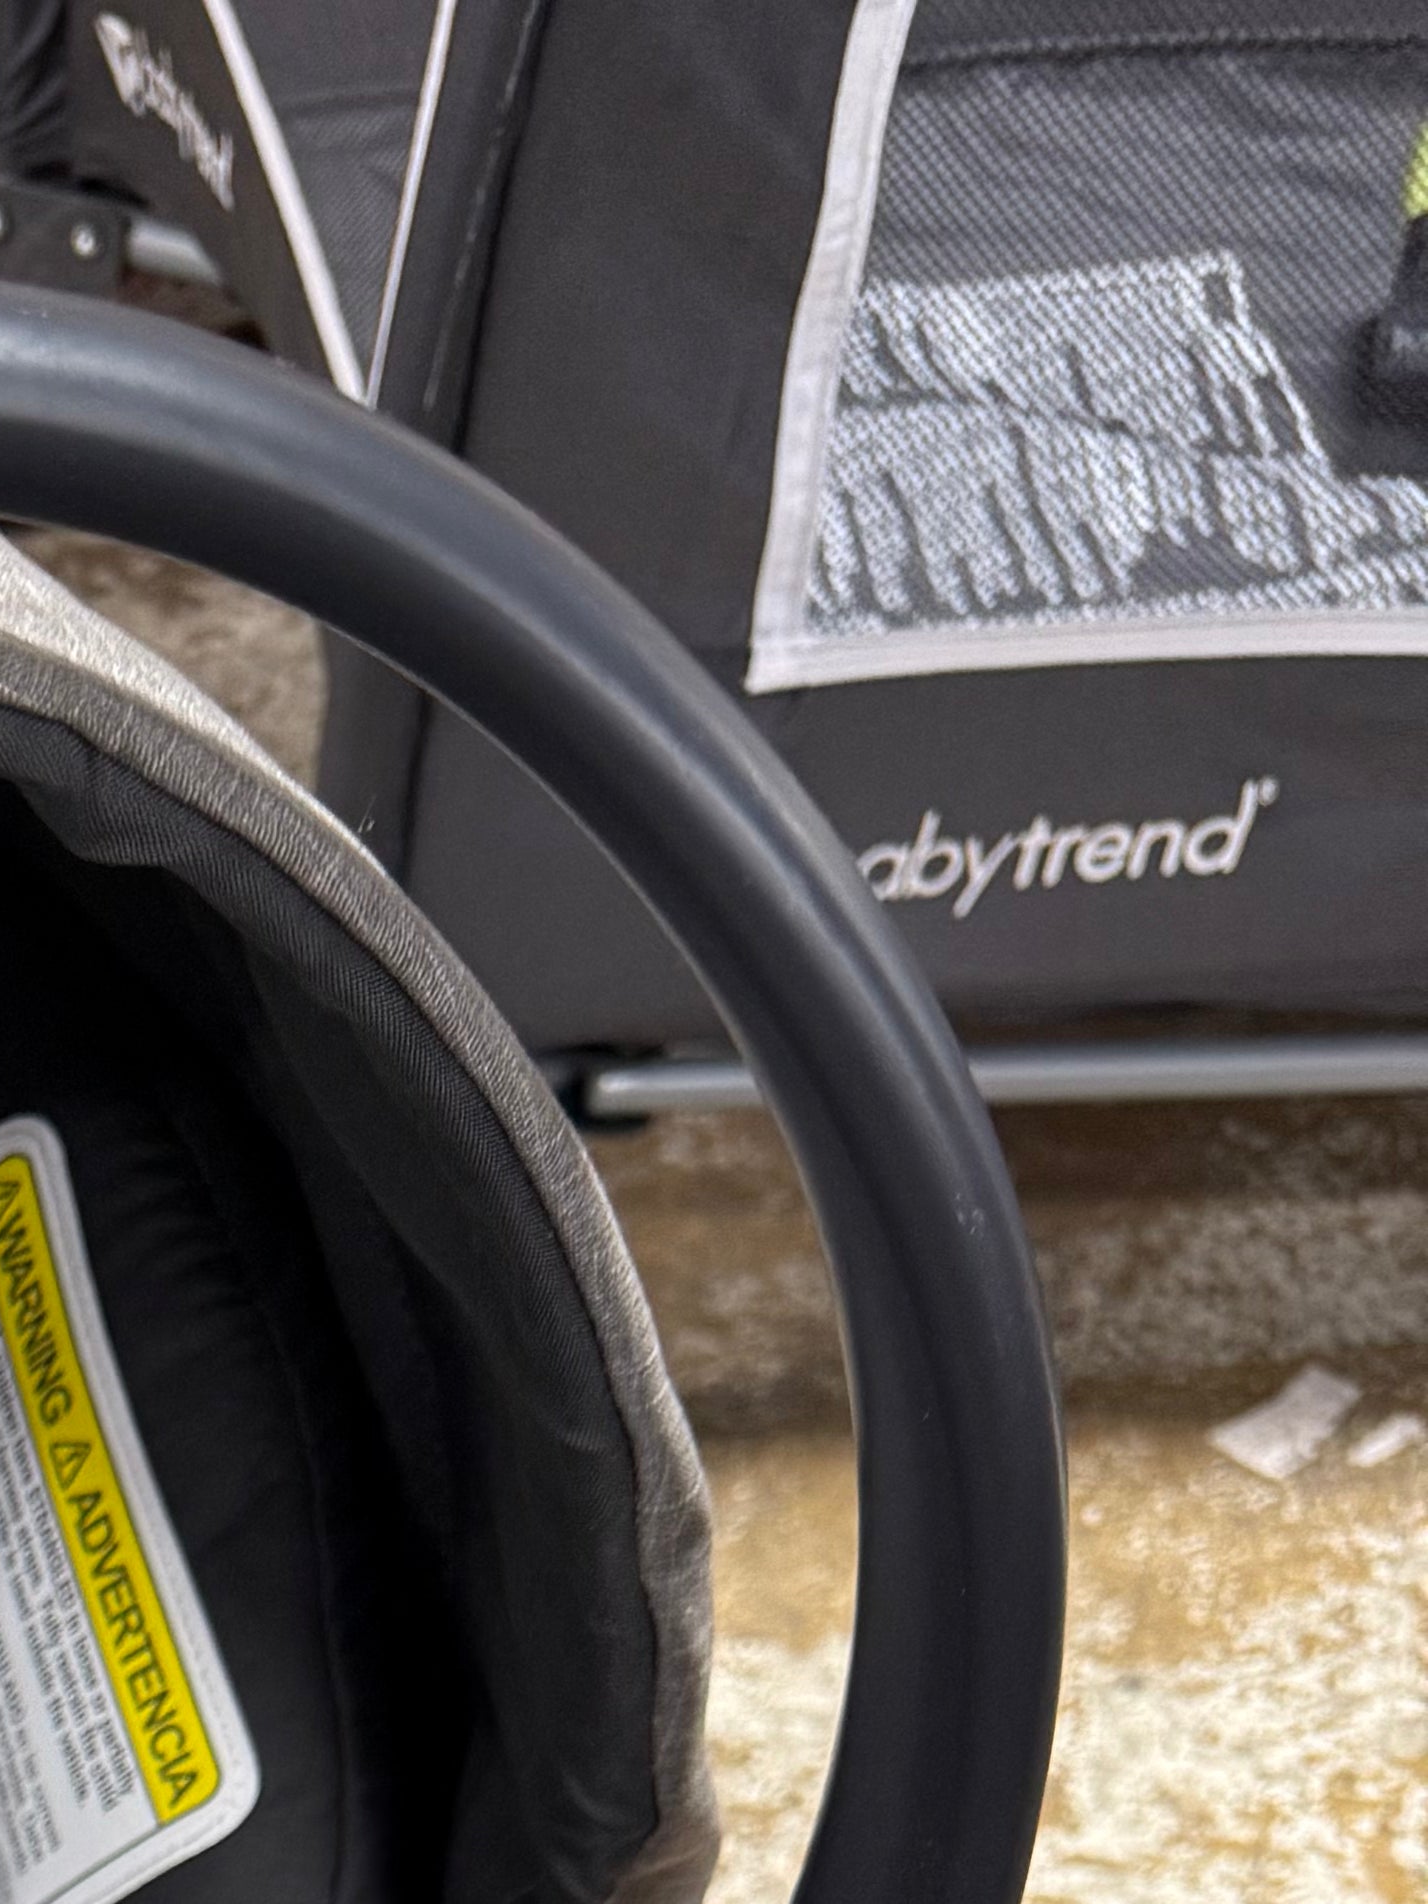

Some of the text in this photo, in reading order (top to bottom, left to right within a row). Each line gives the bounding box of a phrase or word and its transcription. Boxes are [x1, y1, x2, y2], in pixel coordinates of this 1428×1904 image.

[856, 777, 1279, 919] abytrend
[29, 1485, 77, 1610] STRANGLED
[75, 1488, 197, 1806] ADVERTENCIA
